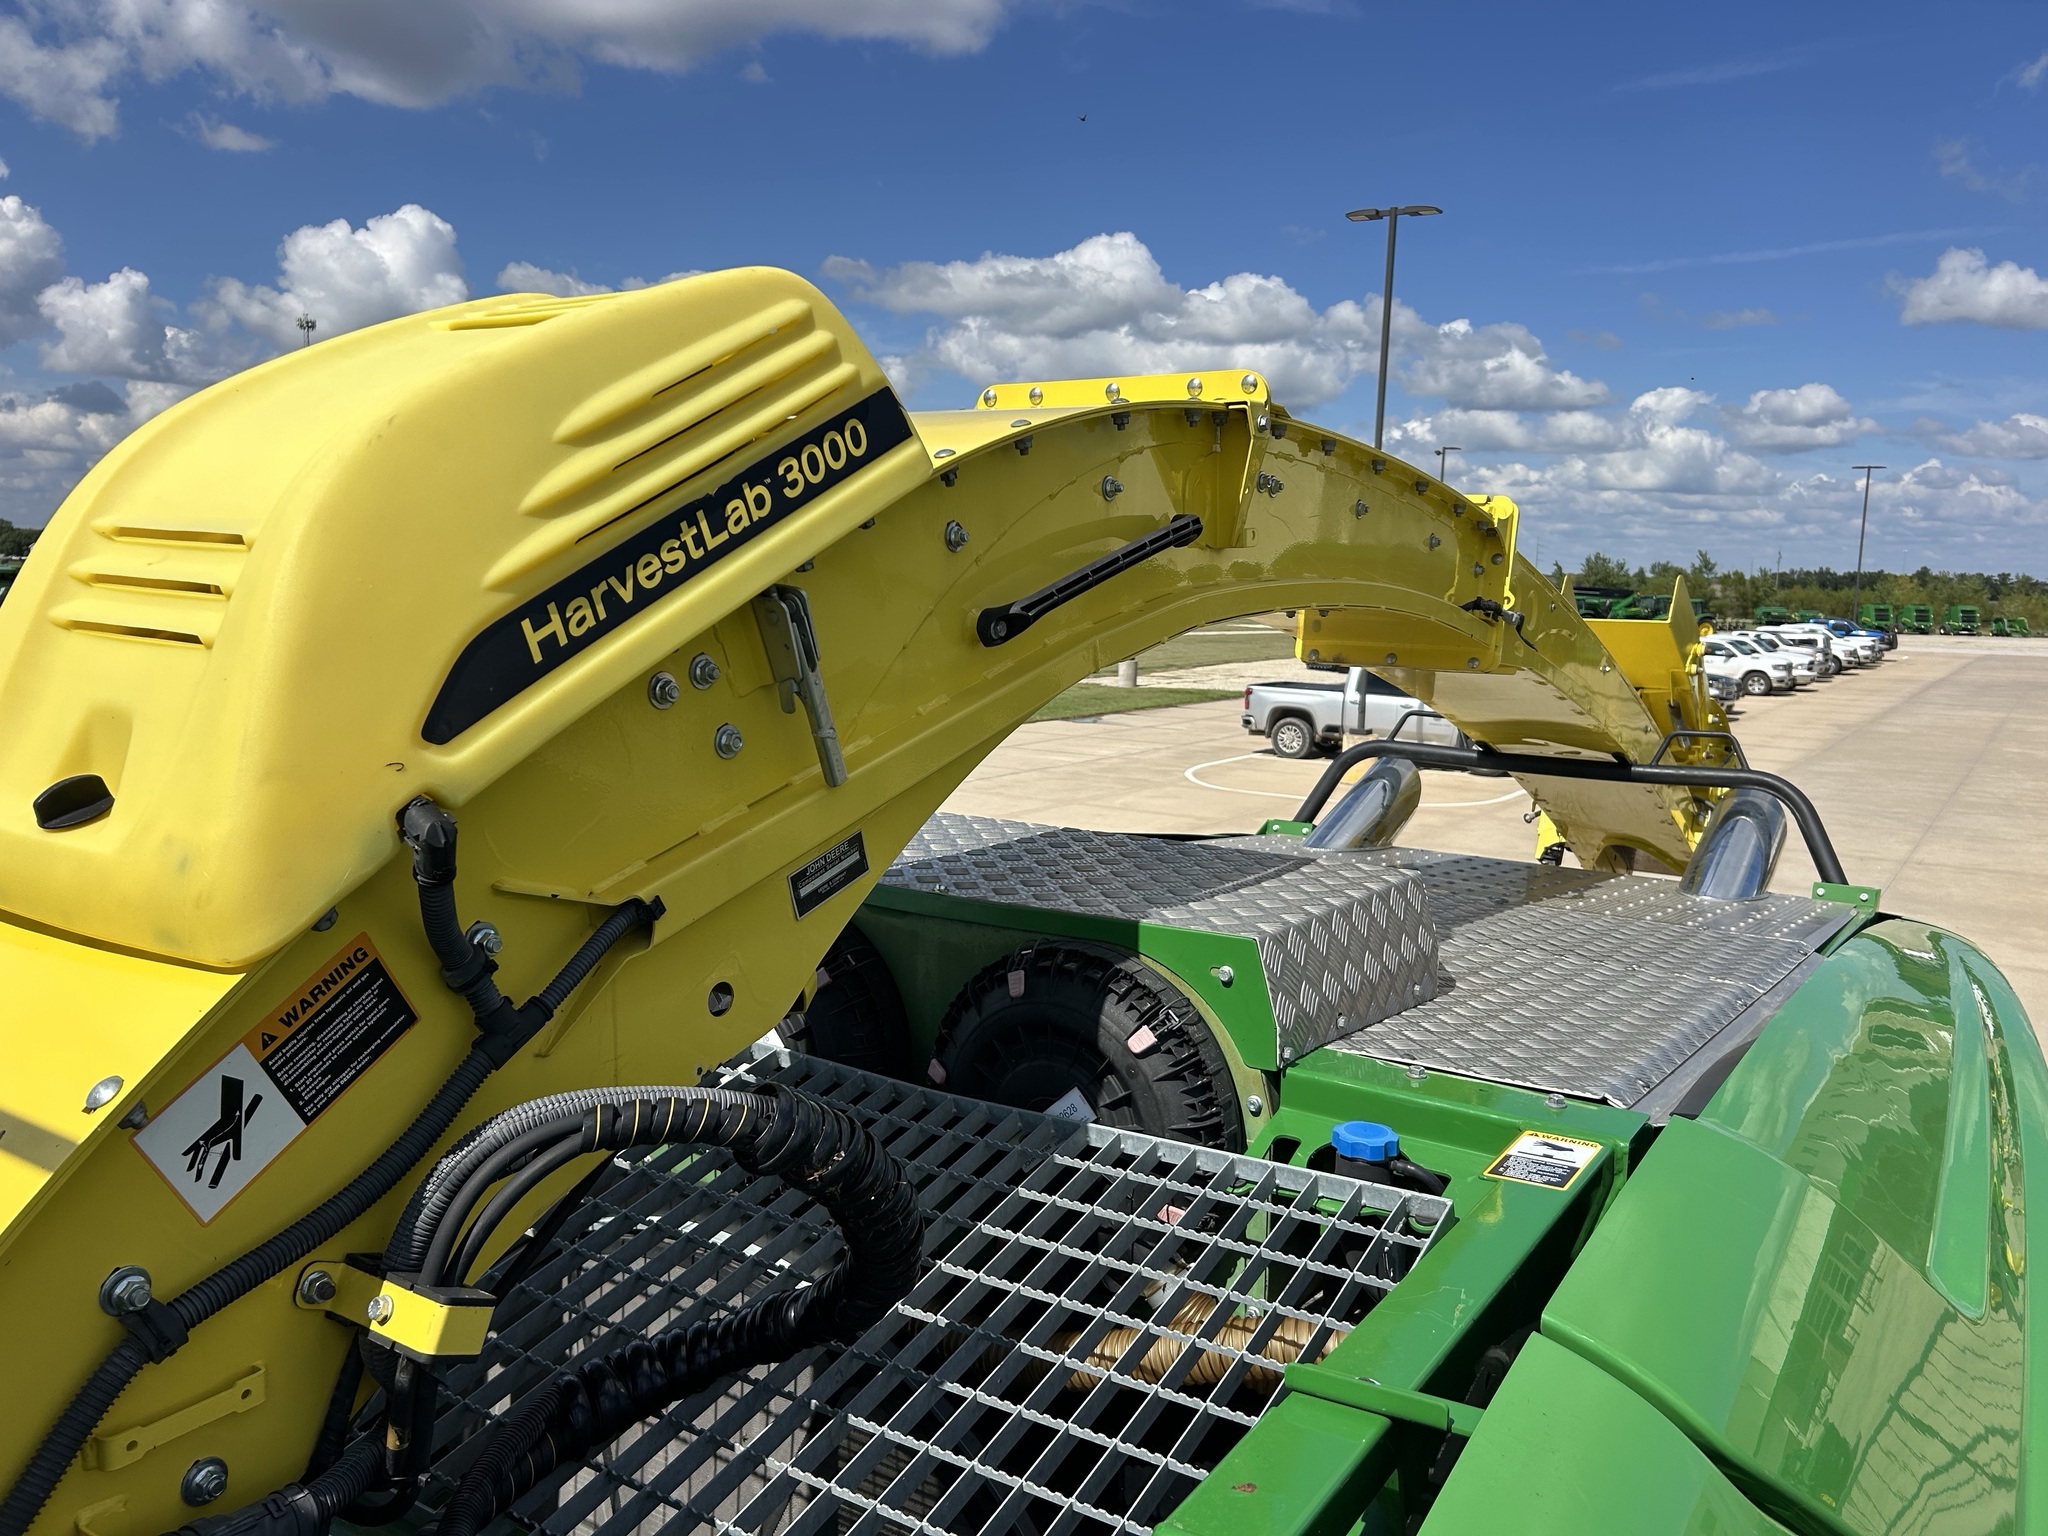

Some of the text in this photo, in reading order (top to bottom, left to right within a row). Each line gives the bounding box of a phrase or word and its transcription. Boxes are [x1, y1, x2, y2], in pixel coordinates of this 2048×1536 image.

[777, 418, 868, 500] 3000
[798, 868, 826, 888] Component
[826, 857, 841, 871] Serial
[840, 846, 859, 861] Number
[805, 841, 850, 876] JOHN DEERE
[268, 1051, 282, 1065] Avoid
[281, 1038, 297, 1053] bodily
[296, 1022, 314, 1039] injuries
[313, 1012, 326, 1023] from
[324, 993, 346, 1013] hydraulic
[352, 979, 361, 988] and
[360, 972, 369, 981] gas
[278, 946, 370, 1029] WARNING
[271, 1036, 308, 1070] under pressure.
[276, 1061, 293, 1077] Before
[316, 1011, 347, 1041] disassembling
[352, 989, 371, 1007] charging
[370, 977, 383, 990] spout
[279, 1073, 288, 1081] lift
[288, 1047, 316, 1074] accumulator
[322, 1022, 343, 1042] removing
[342, 1004, 362, 1023] hydraulic
[362, 994, 373, 1004] lines
[283, 1054, 316, 1086] disassembling
[316, 1020, 353, 1055] electro-hydraulic
[352, 1009, 364, 1020] valve
[294, 1075, 307, 1087] Start
[306, 1060, 322, 1076] engine
[322, 1051, 332, 1061] and
[331, 1040, 344, 1053] press
[344, 1026, 359, 1040] switch
[365, 1007, 378, 1020] spout
[378, 997, 389, 1009] down
[297, 1083, 305, 1091] for
[312, 1059, 331, 1078] seconds
[336, 1040, 352, 1055] relieve
[352, 1025, 368, 1040] system
[367, 1007, 386, 1026] hydraulic
[301, 1076, 321, 1096] pressure
[303, 1102, 313, 1112] Use
[313, 1092, 324, 1103] only
[323, 1085, 332, 1093] dry
[331, 1067, 351, 1086] nitrogen
[357, 1038, 381, 1061] recharging
[303, 1089, 315, 1100] Stop
[315, 1074, 331, 1089] engine
[306, 1107, 316, 1116] See
[316, 1096, 327, 1108] your
[327, 1083, 340, 1097] JOHN
[339, 1068, 356, 1084] DEERE
[1056, 1103, 1078, 1119] 2628
[1541, 1134, 1598, 1149] WARNING
